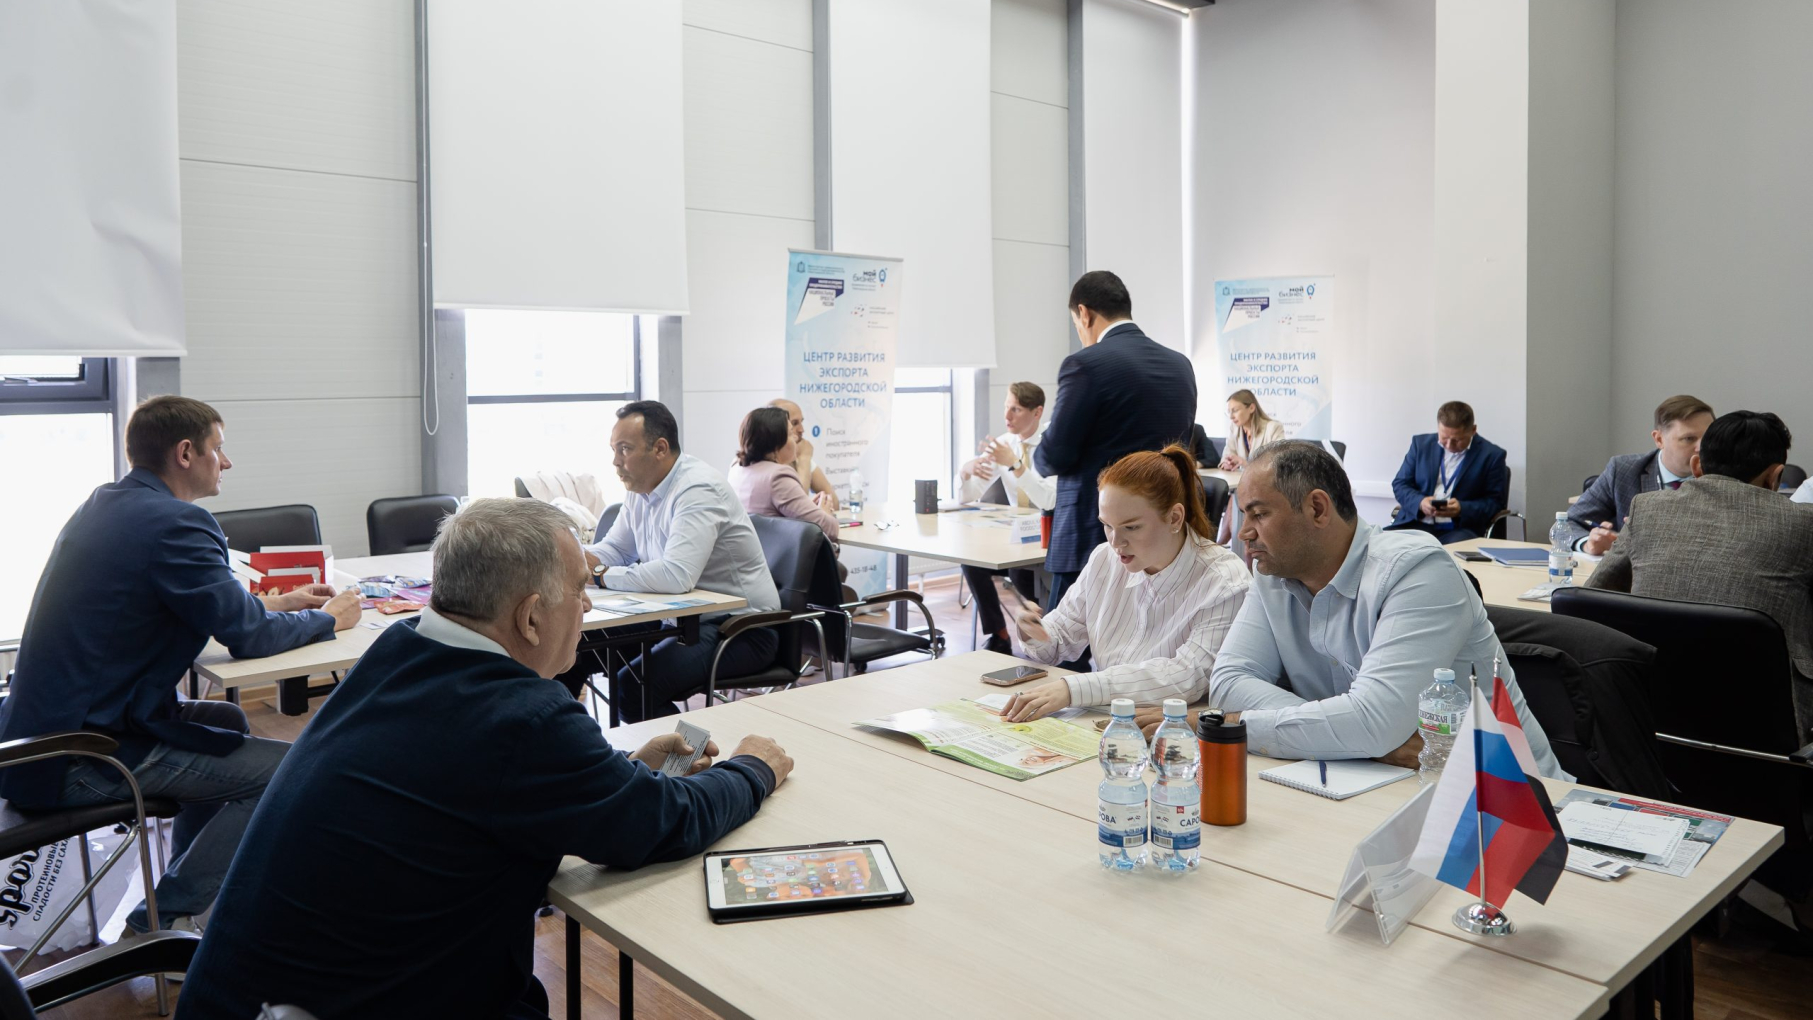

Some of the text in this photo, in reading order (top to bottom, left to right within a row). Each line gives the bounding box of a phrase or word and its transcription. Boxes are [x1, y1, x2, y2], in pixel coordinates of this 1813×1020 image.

[803, 351, 885, 363] ЦЕНТР РАЗВИТИЯ
[1230, 352, 1316, 361] ЦЕНТР РАЗВИТИЯ
[819, 367, 869, 378] ЭКСПОРТА
[1247, 364, 1299, 373] ЭКСПОРТА
[1227, 375, 1319, 385] НИЖЕГОРОДСКОЙ
[799, 381, 887, 394] НИЖЕГОРОДСКОЙ
[820, 398, 865, 409] ОБЛАСТИ
[826, 428, 846, 436] Поиск
[825, 439, 869, 449] иностранного
[825, 451, 860, 460] покупателя
[1180, 816, 1200, 827] САРО
[31, 841, 59, 904] ПРОТЕИНОВЫЕ
[32, 875, 57, 922] СЛАДОСТИ
[53, 858, 63, 875] БЕЗ
